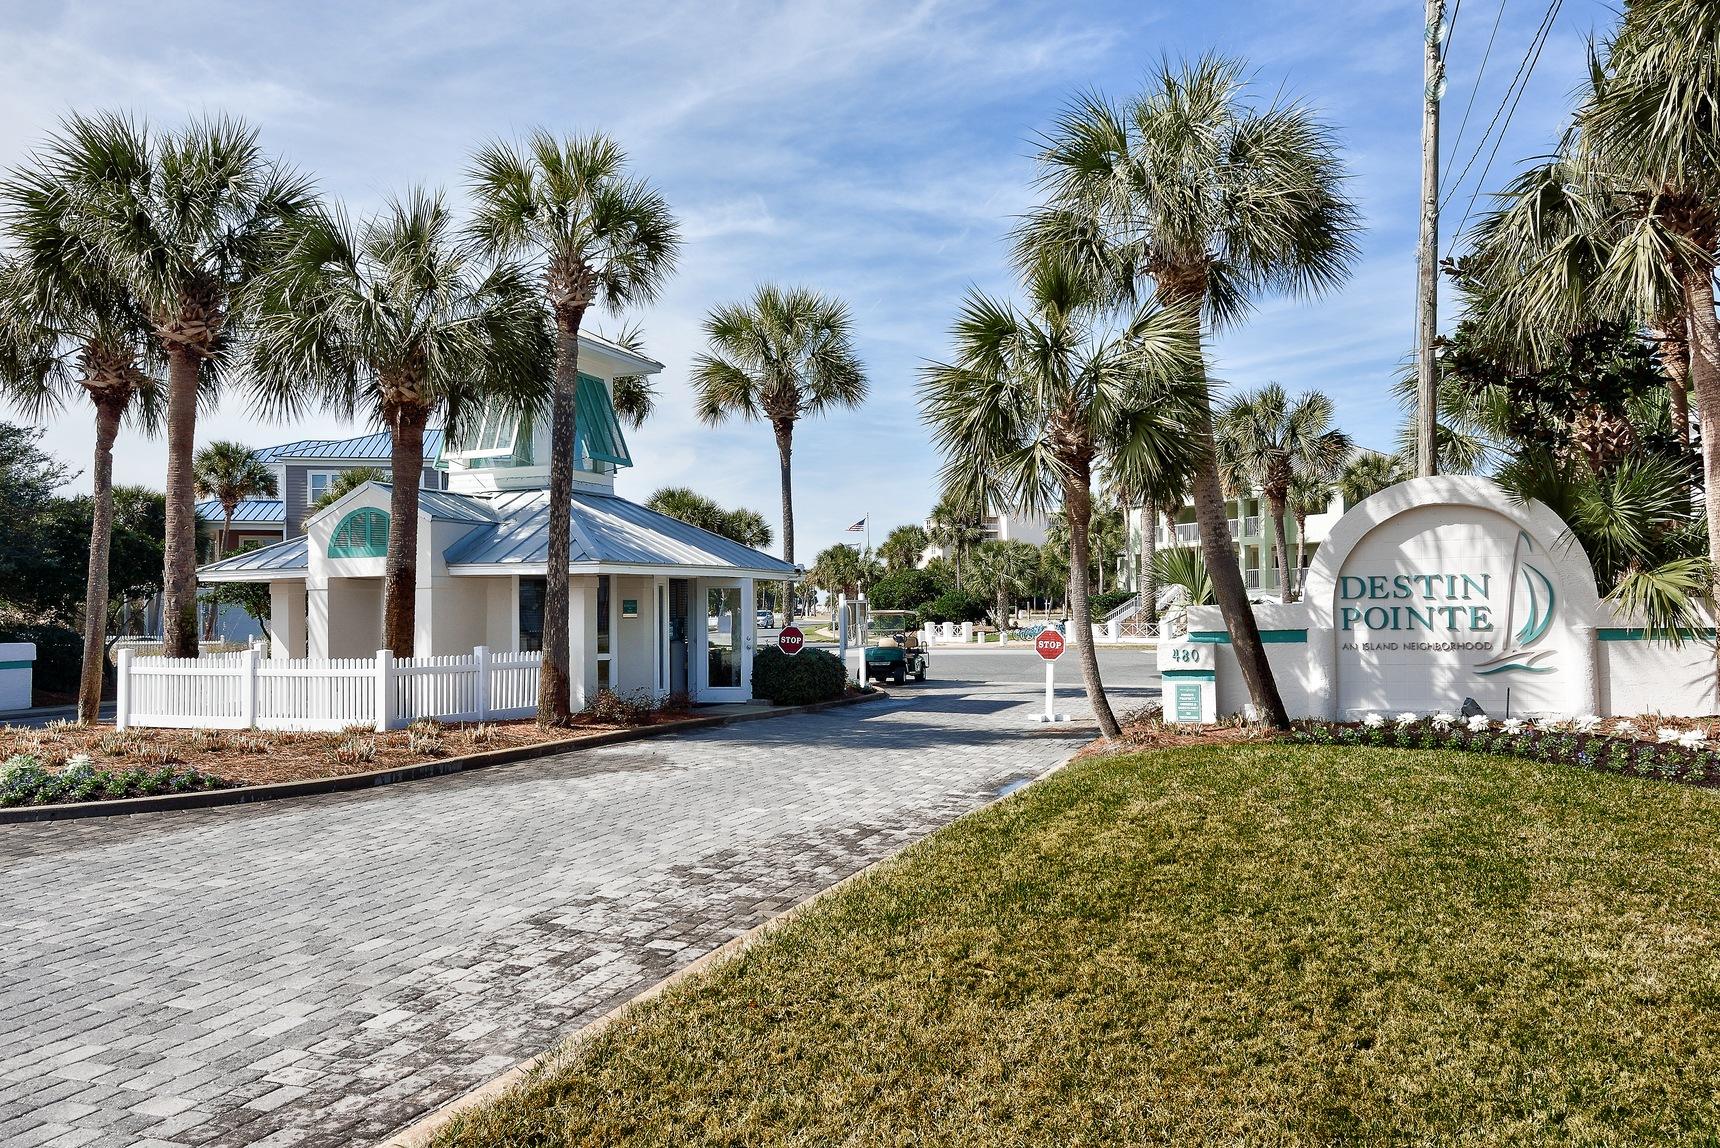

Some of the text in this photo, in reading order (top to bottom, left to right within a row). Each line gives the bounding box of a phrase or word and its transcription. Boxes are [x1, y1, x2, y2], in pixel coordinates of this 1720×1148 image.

[1340, 574, 1491, 600] DESTIN
[1341, 605, 1494, 632] POINTE
[780, 636, 802, 644] STOP
[1038, 641, 1062, 649] STOP
[1342, 641, 1493, 652] AN ISLAND NEIGHBORHOOD
[1173, 649, 1200, 663] 480
